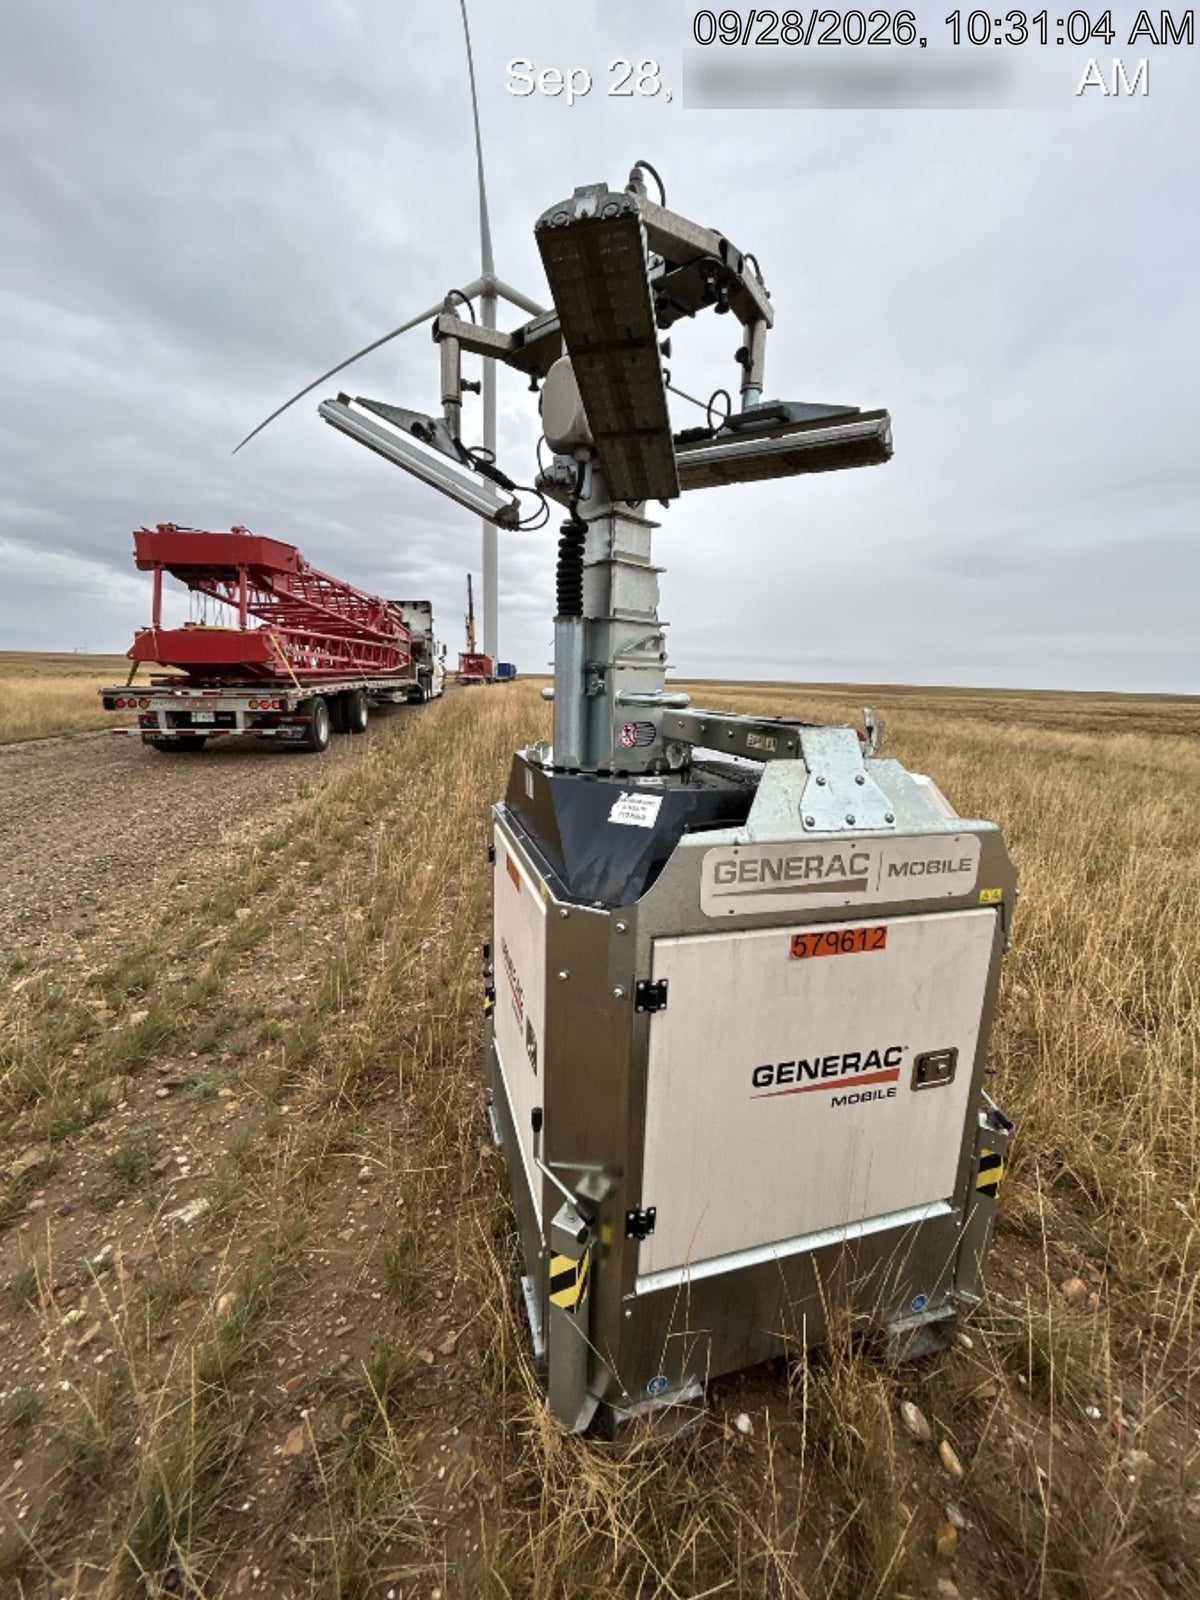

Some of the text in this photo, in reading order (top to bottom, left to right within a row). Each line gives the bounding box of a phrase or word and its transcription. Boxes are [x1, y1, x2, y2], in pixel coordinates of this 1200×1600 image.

[714, 853, 870, 884] GENERAC
[887, 858, 972, 877] MOBILE
[793, 927, 887, 957] 579612
[752, 1046, 903, 1088] GENERAC
[830, 1087, 897, 1108] MOBILE
